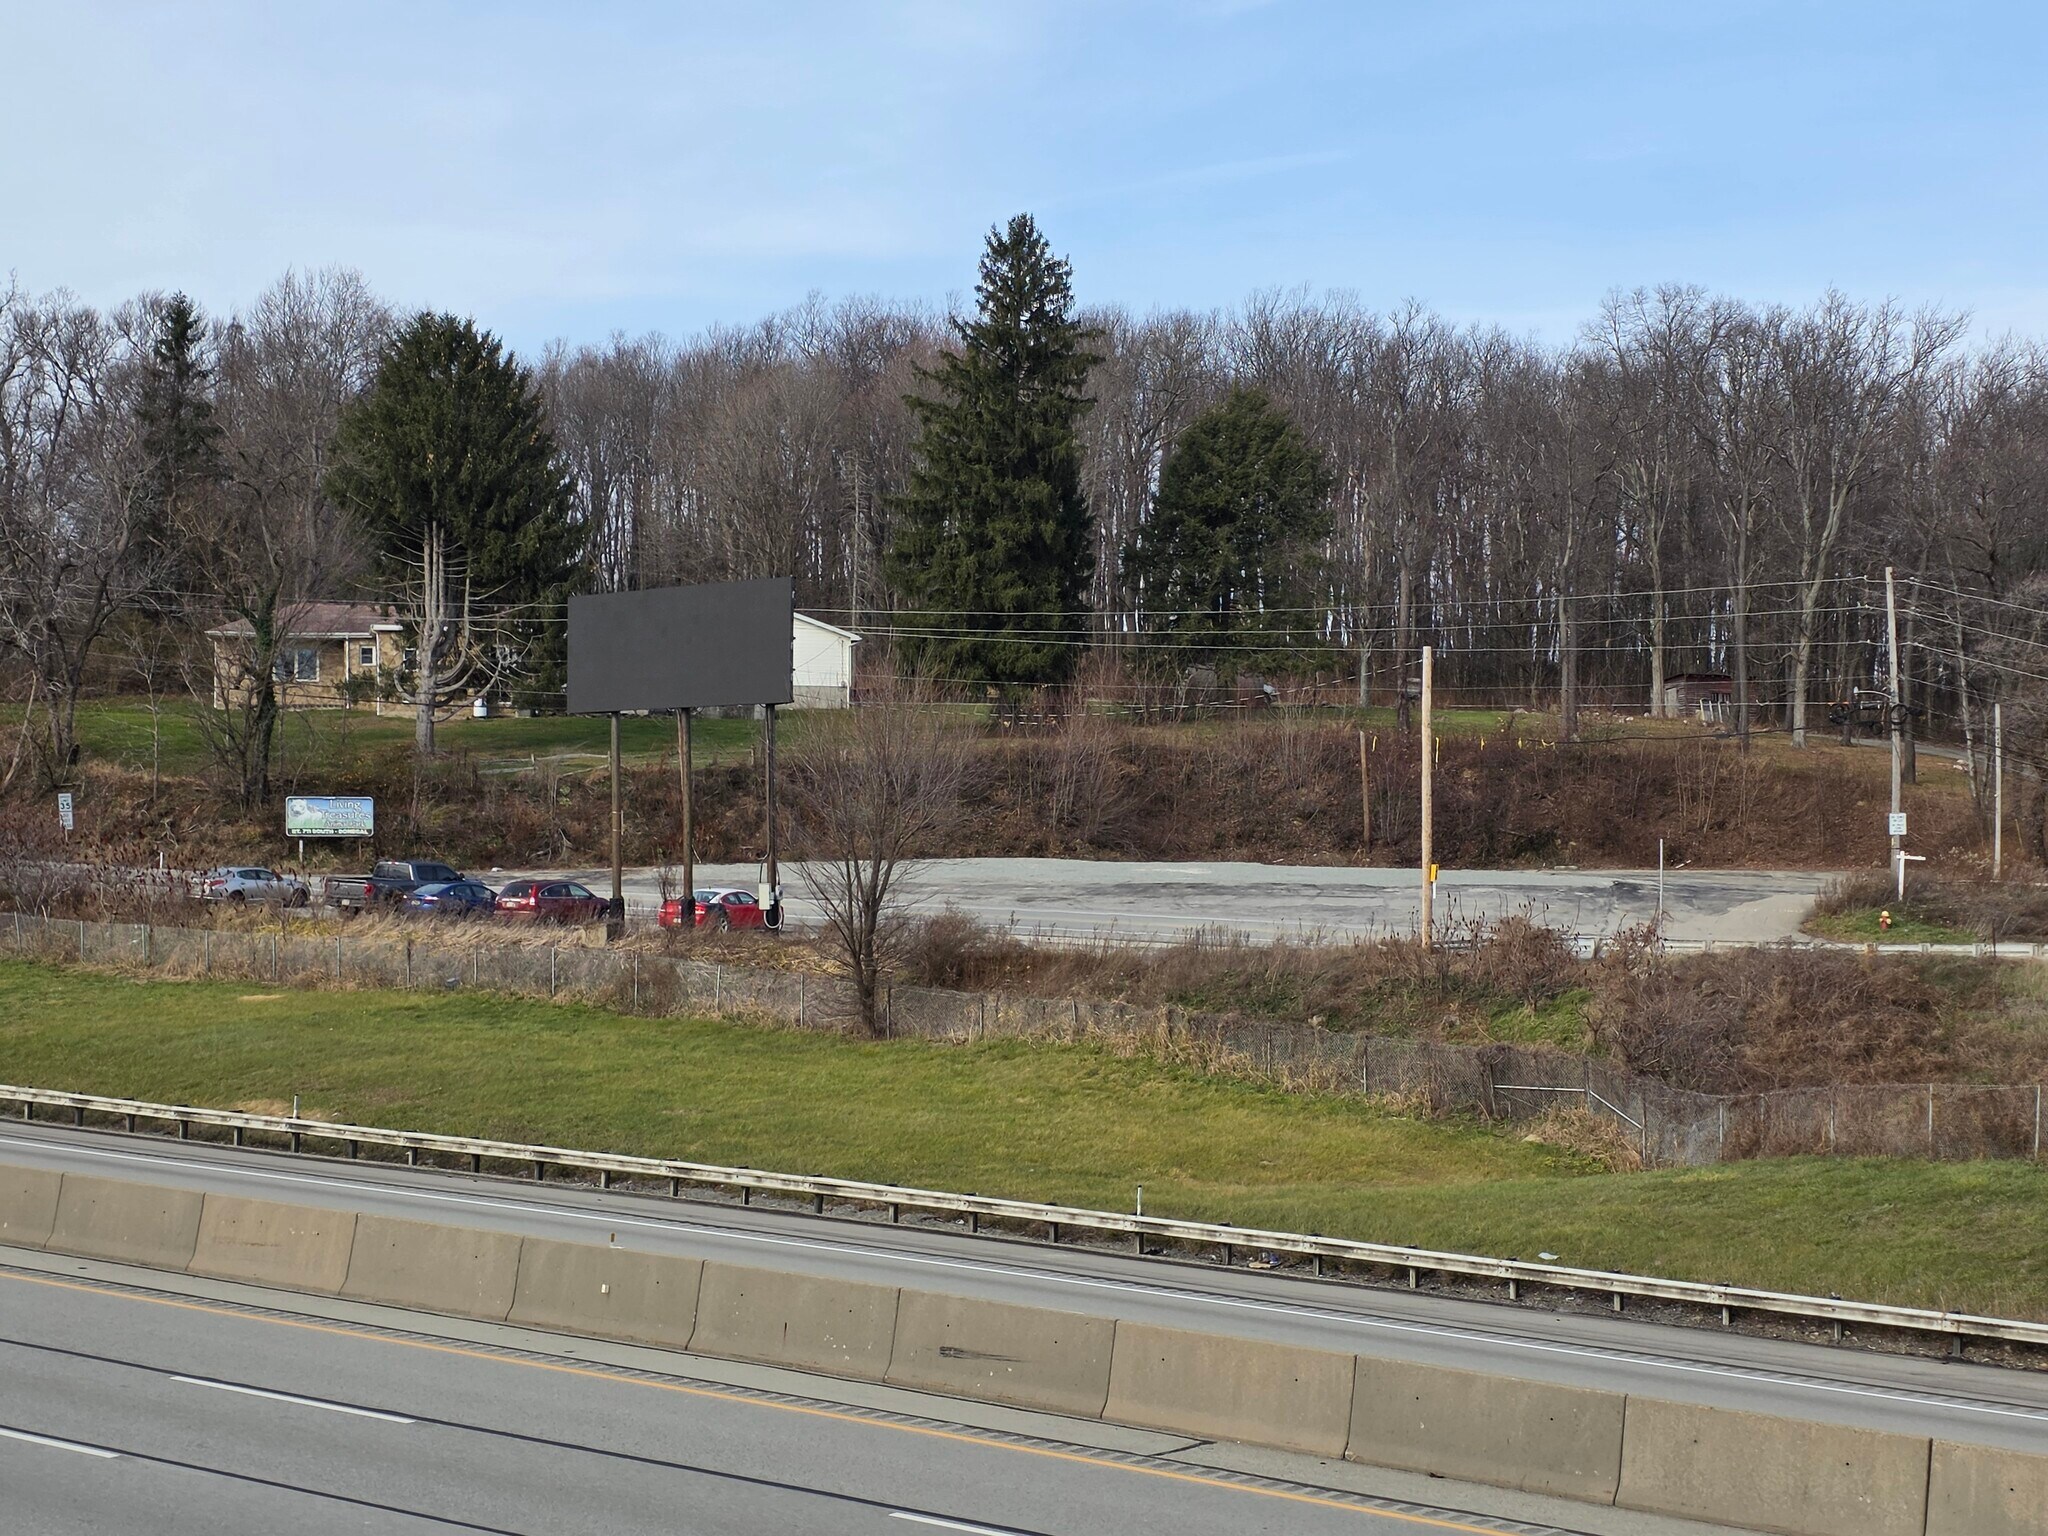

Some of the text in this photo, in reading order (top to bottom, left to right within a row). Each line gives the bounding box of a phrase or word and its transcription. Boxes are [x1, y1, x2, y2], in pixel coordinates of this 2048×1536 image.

[60, 802, 70, 810] 35
[329, 799, 362, 812] Living
[321, 810, 371, 820] Treasures
